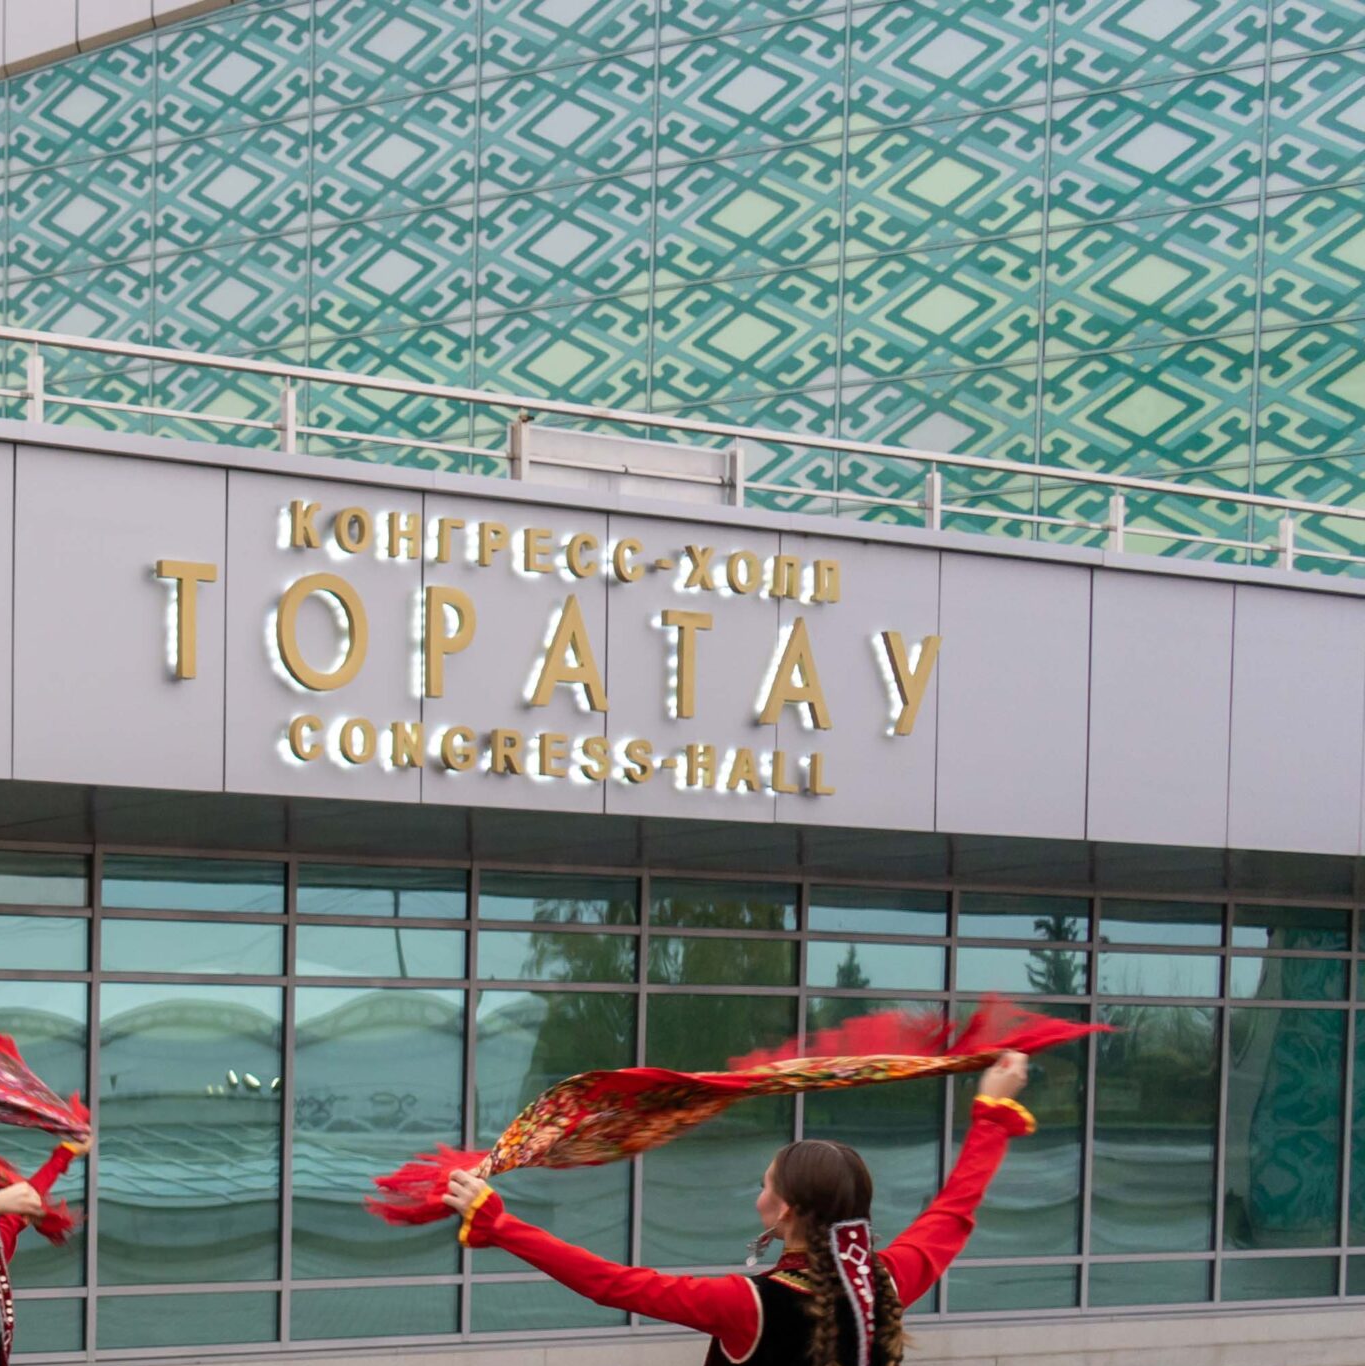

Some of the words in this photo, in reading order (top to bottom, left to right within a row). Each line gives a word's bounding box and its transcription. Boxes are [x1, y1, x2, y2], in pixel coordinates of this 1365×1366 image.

[289, 499, 842, 604] КОНГРЕСС-ХОЛЛ
[155, 559, 943, 737] ТОРАТАУ
[287, 713, 837, 797] CONGRESS-HALL
